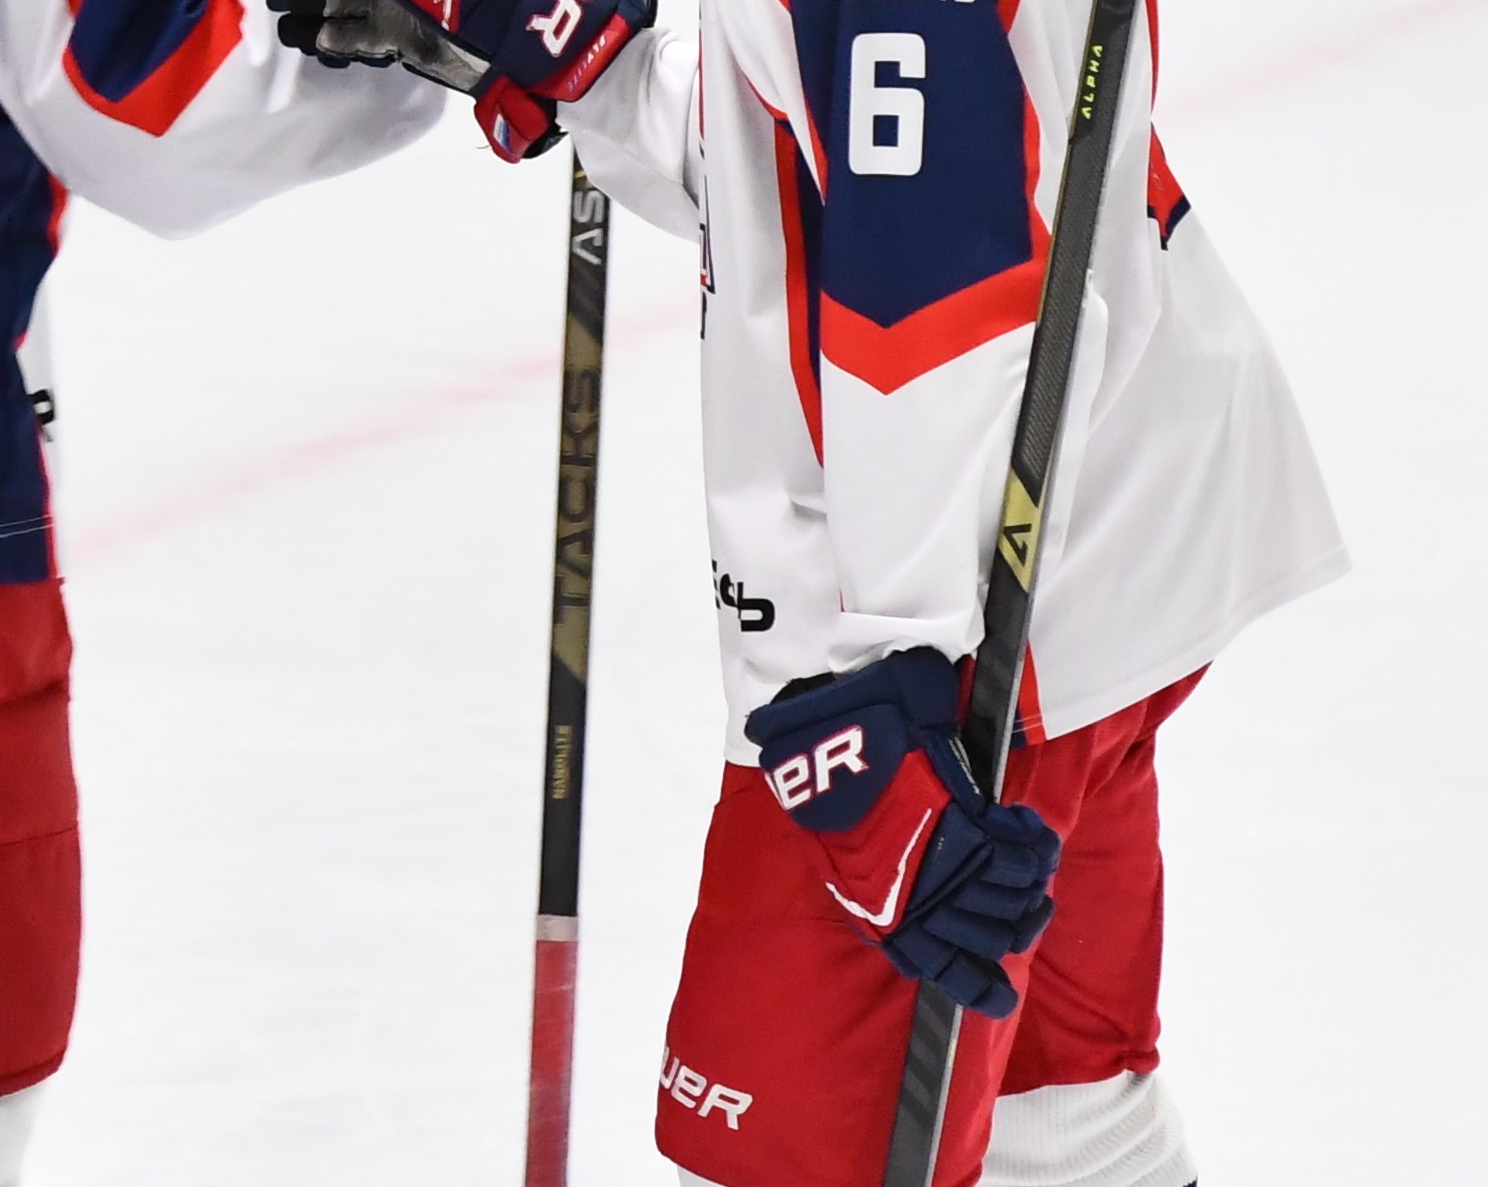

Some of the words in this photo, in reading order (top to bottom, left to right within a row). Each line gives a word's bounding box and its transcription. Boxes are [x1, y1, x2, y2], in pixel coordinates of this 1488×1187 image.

[848, 32, 926, 177] 6
[1081, 43, 1103, 120] ALPHA
[553, 365, 600, 624] TACKS
[765, 724, 869, 810] ER
